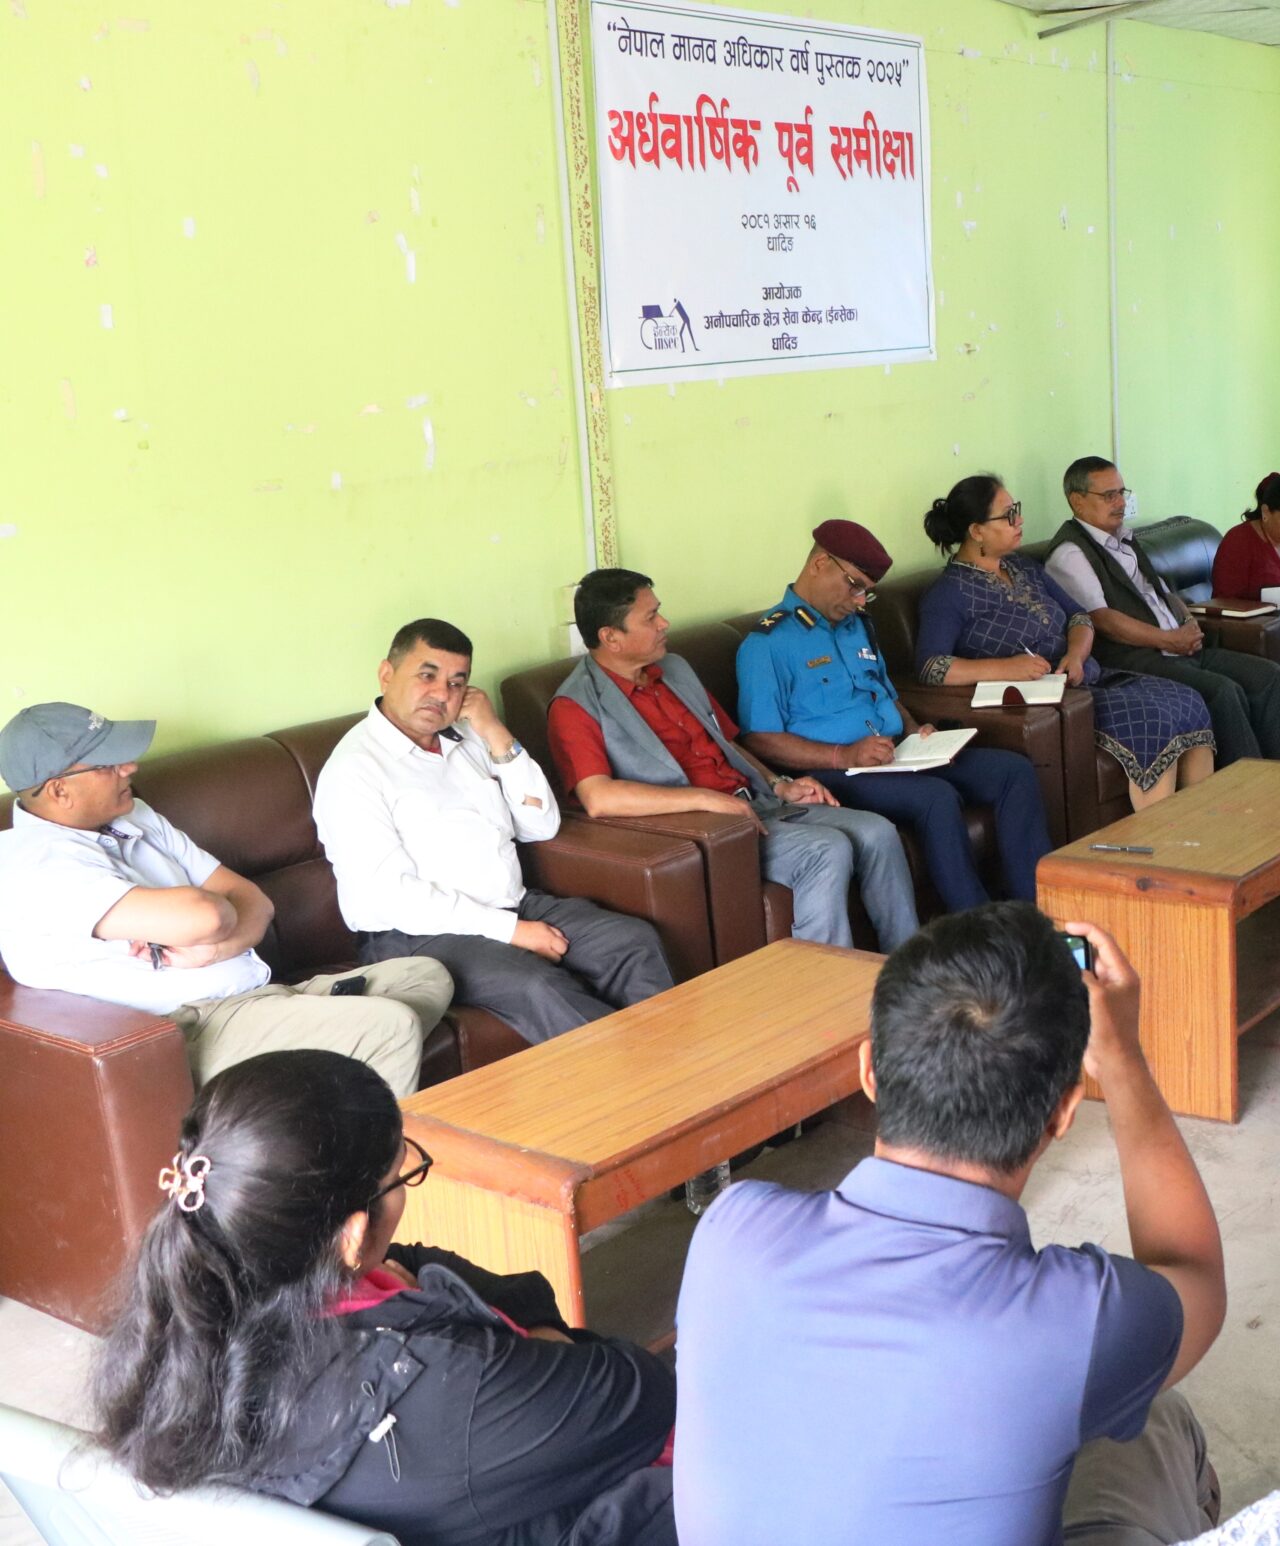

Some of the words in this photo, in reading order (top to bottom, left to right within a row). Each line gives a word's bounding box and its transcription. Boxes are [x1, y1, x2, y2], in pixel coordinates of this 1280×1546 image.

[671, 33, 717, 65] मानव
[723, 35, 784, 73] अधिकार
[789, 40, 810, 75] वर्ष
[815, 51, 861, 86] पुस्तक
[607, 91, 761, 175] अर्धवार्षिक
[774, 105, 814, 193] पूर्व
[829, 110, 915, 181] समीक्षा
[741, 214, 770, 230] २०८१
[773, 214, 800, 230] असार
[762, 282, 802, 301] आयोजक
[763, 308, 780, 328] क्षेत्र
[783, 307, 799, 326] सेवा
